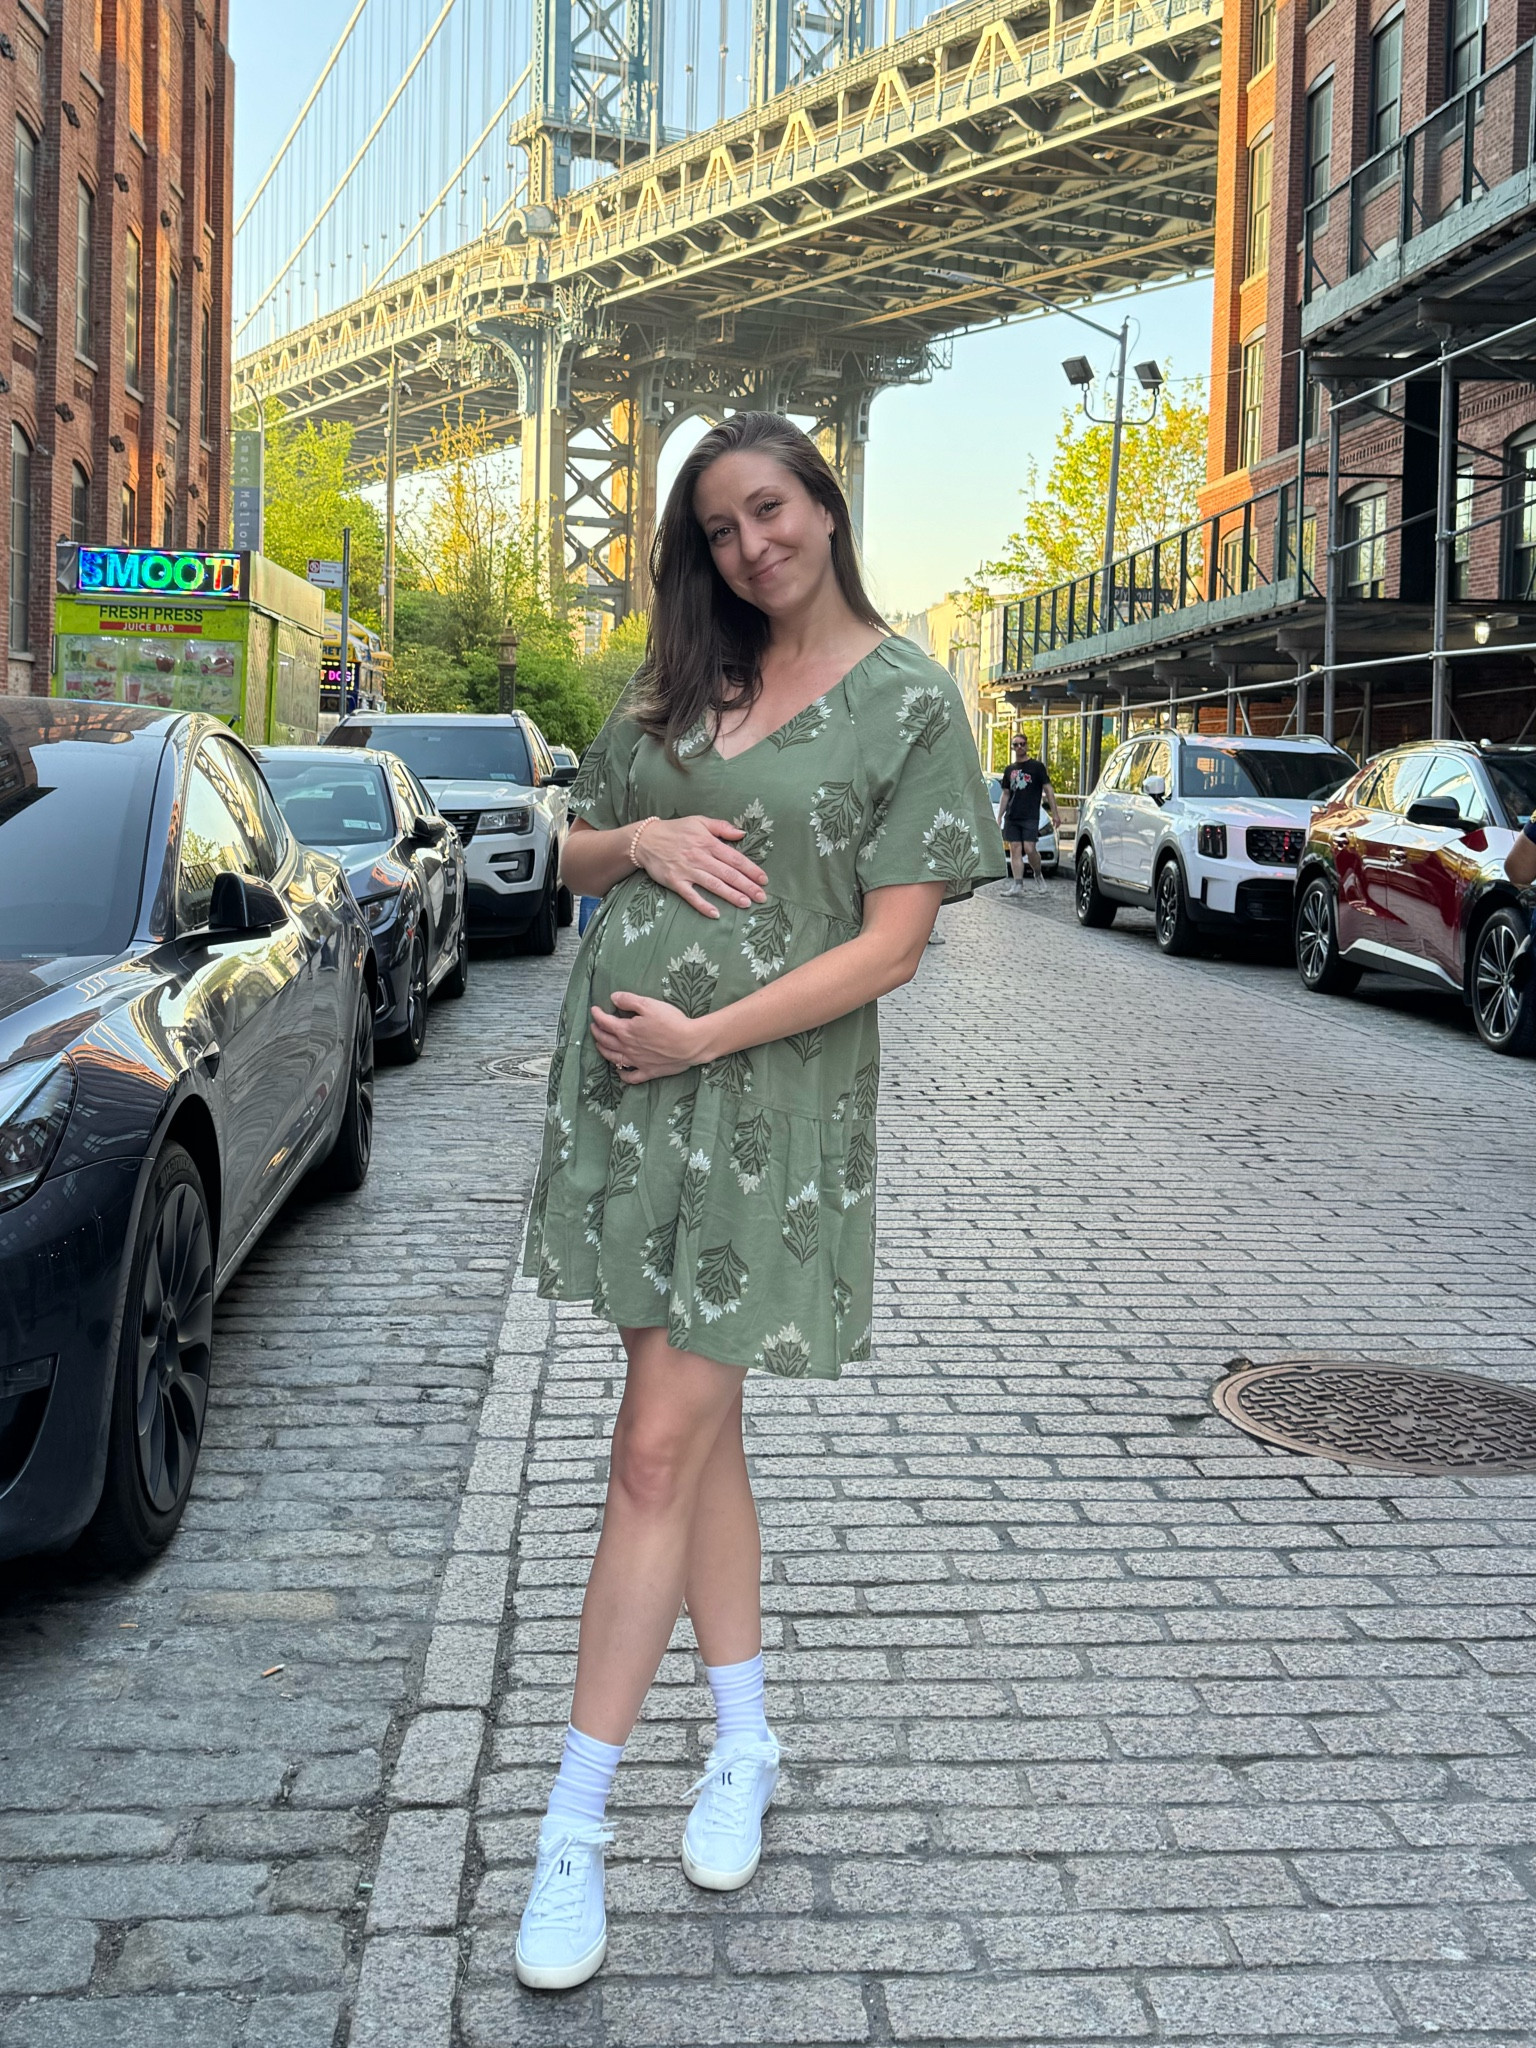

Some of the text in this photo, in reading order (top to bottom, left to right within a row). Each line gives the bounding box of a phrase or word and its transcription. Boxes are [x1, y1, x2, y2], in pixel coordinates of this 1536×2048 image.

[239, 435, 251, 548] Smack Mellon
[1114, 588, 1153, 601] Plyout
[99, 605, 203, 622] FRESH PRESS
[122, 622, 174, 633] JUICE BAR
